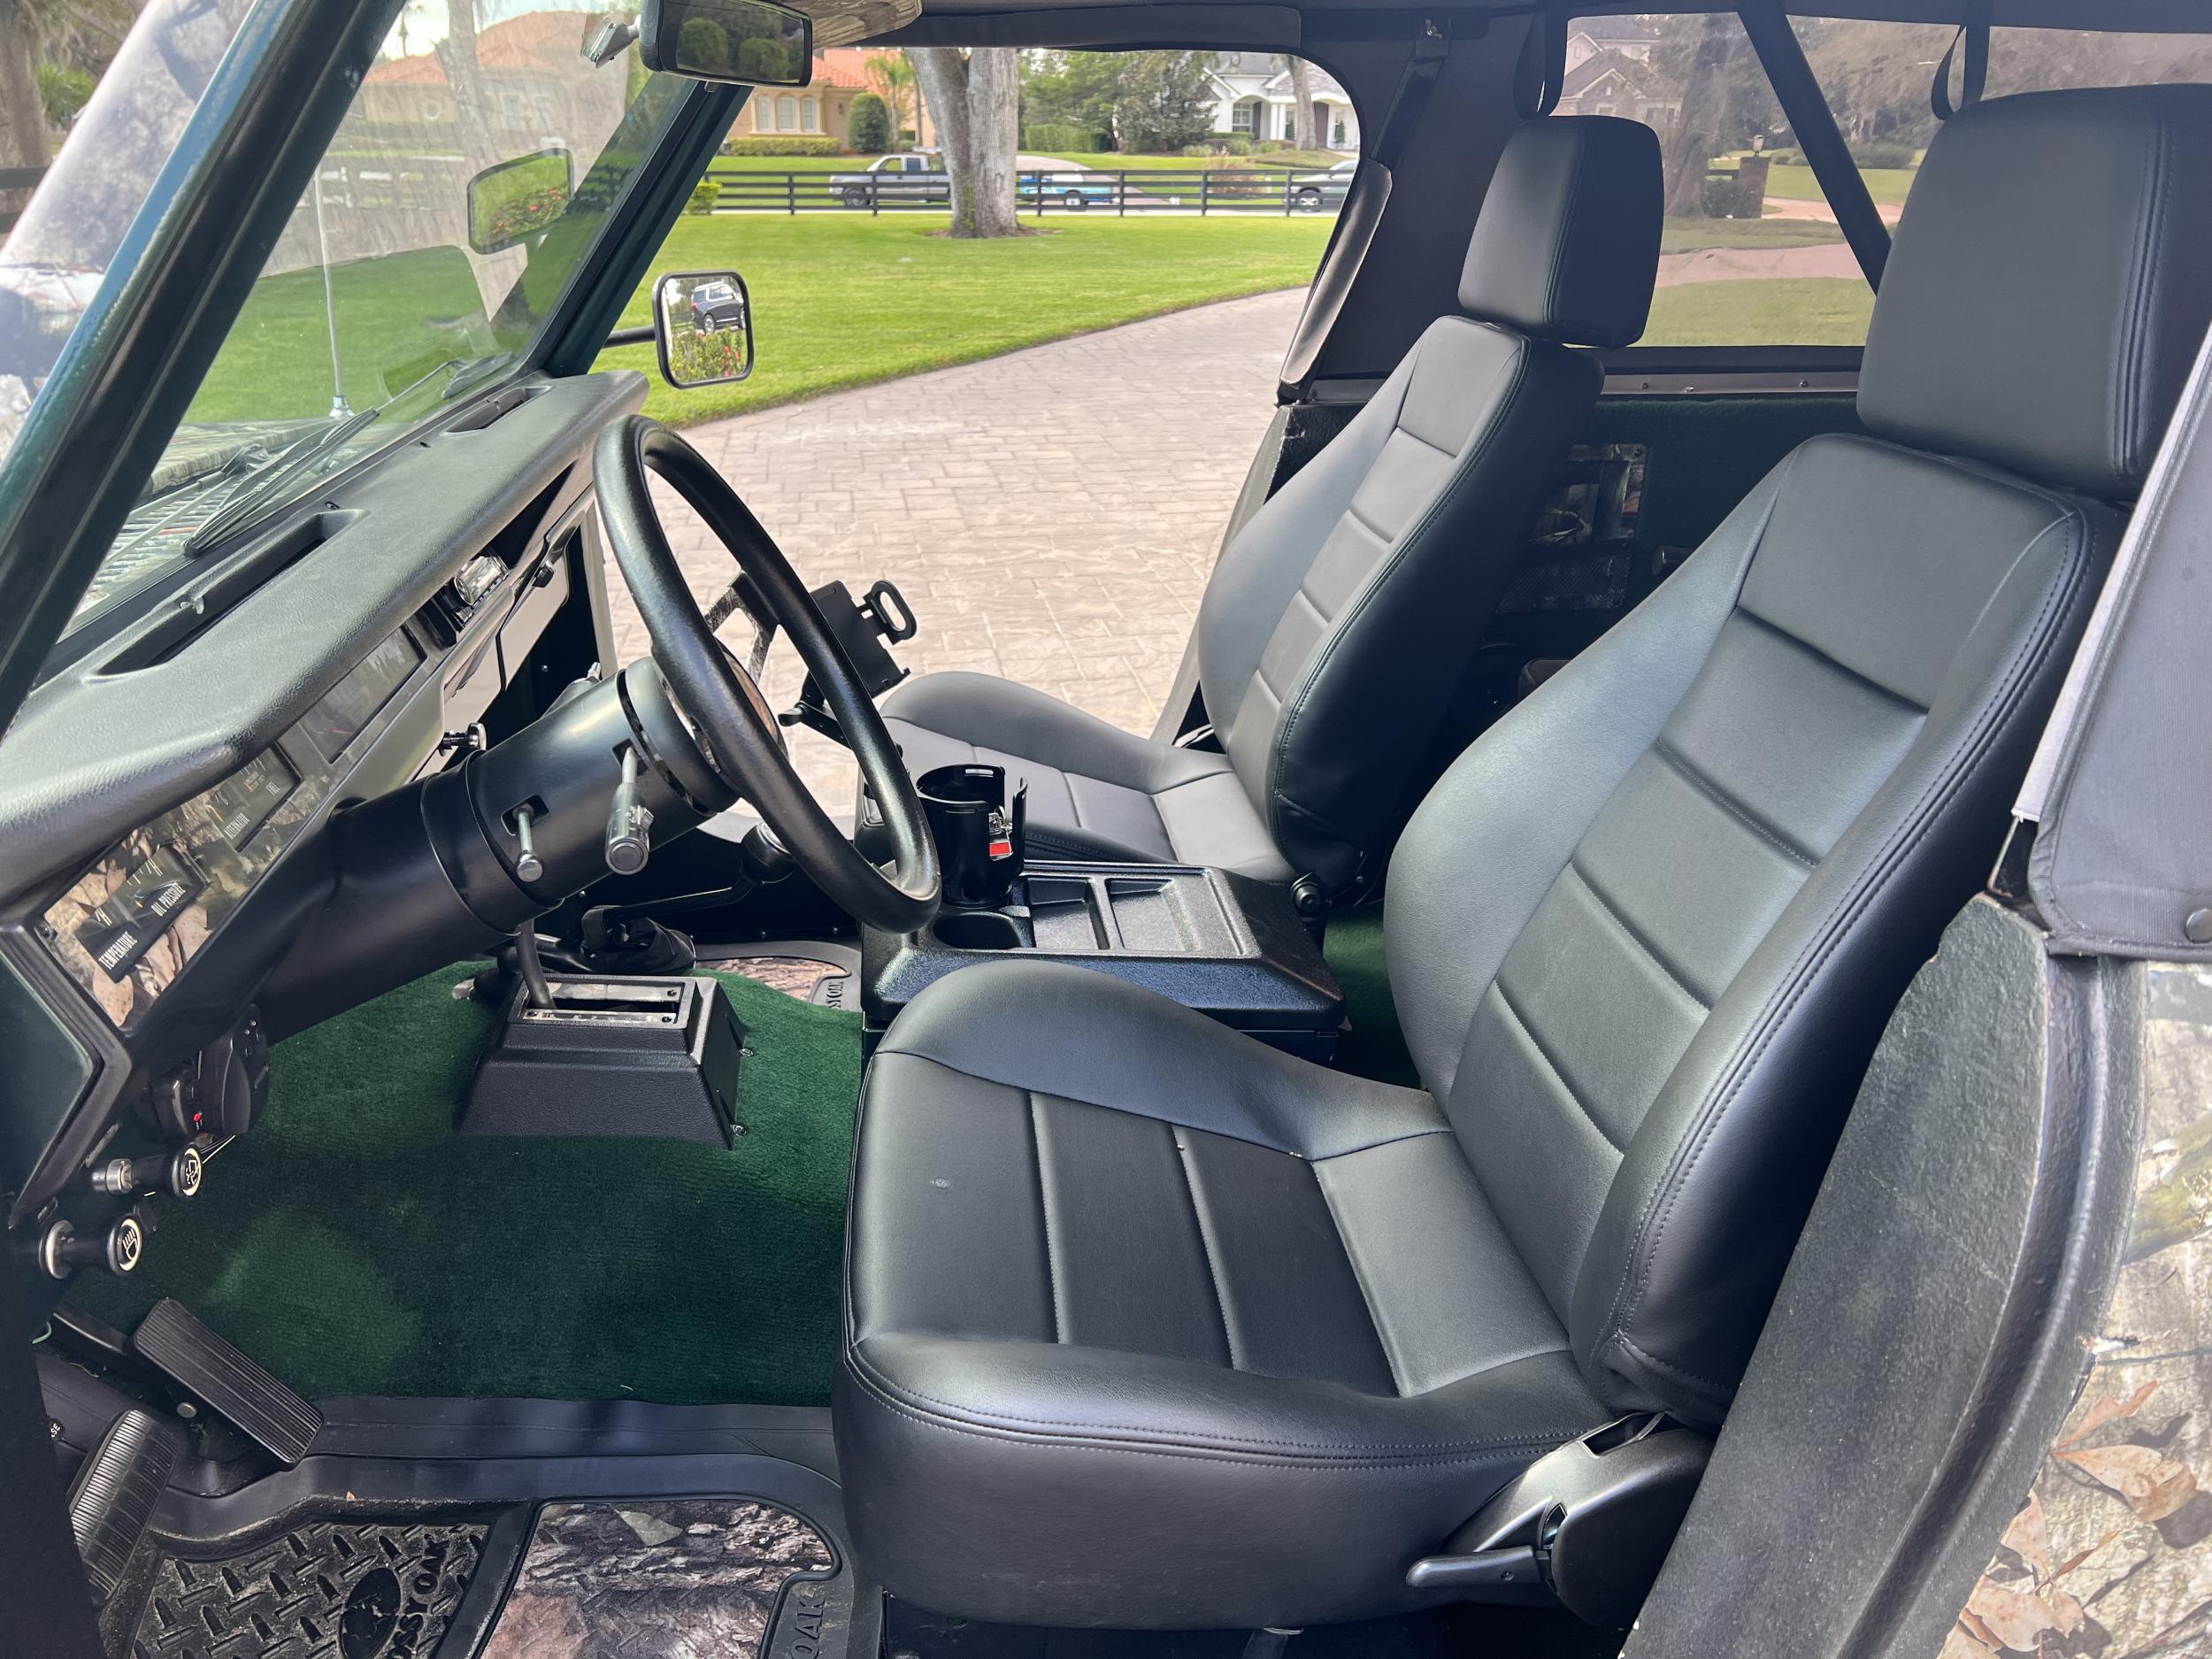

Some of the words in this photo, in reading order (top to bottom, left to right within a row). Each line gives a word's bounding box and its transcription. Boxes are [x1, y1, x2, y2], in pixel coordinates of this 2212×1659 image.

[223, 812, 250, 840] ALTERNATOR
[150, 902, 167, 917] OIL
[158, 882, 187, 909] PRESSURE
[98, 931, 138, 970] TEMPERATURE
[50, 1423, 61, 1438] SE
[384, 1596, 430, 1659] OSSY
[413, 1532, 450, 1595] OAK
[790, 1594, 826, 1659] OAK
